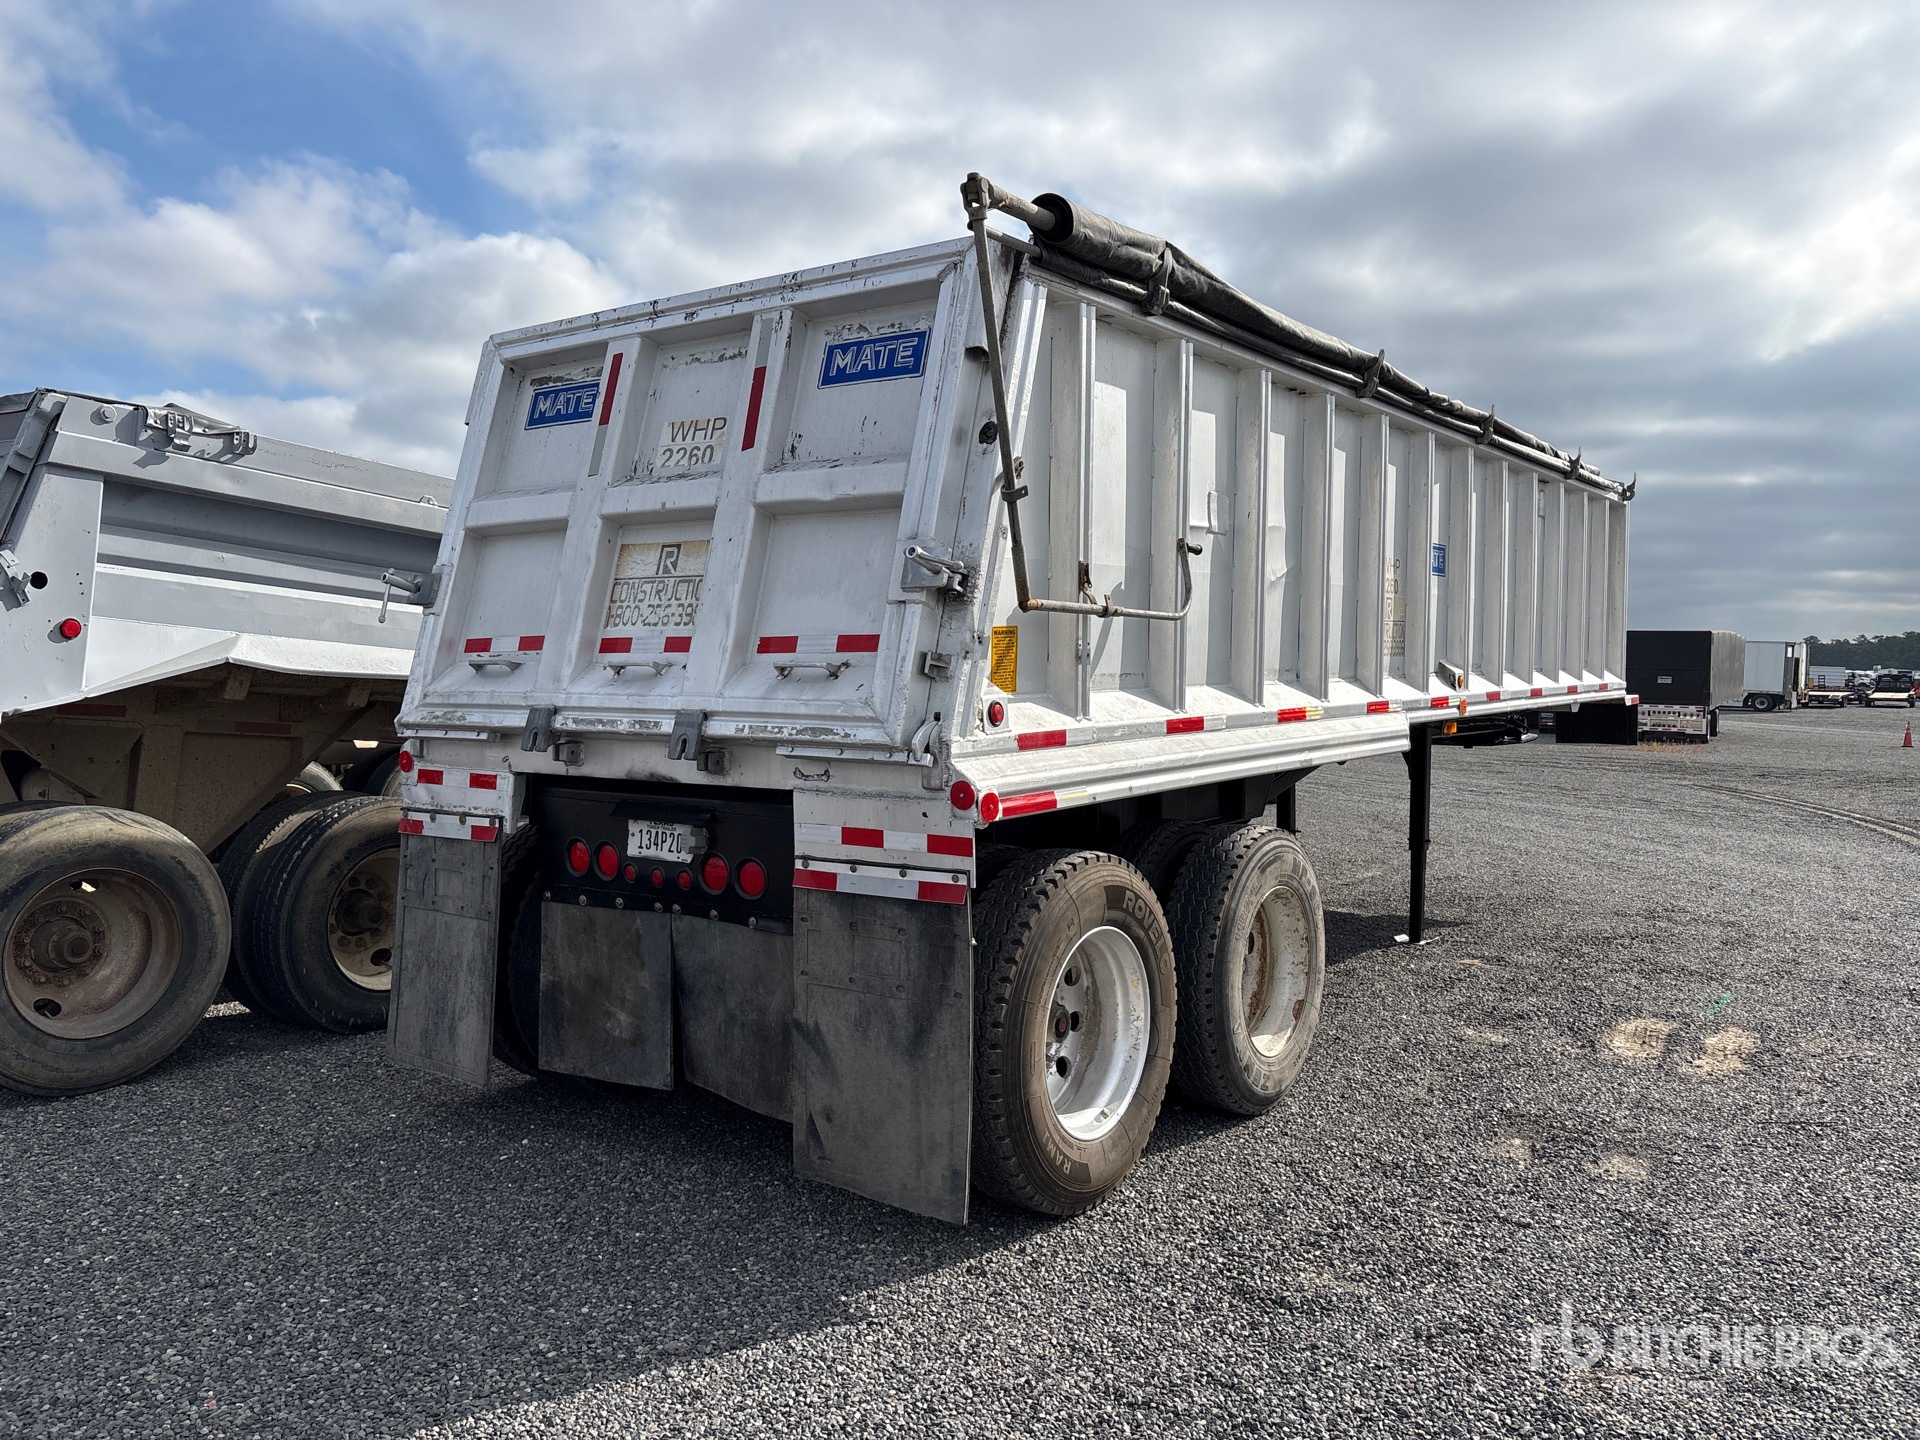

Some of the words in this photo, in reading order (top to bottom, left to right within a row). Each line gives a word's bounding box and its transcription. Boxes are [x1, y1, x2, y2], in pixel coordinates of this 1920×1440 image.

[829, 337, 918, 376] MATE
[533, 387, 597, 419] MATE
[671, 416, 727, 443] WHP
[660, 444, 715, 468] 2260
[1123, 889, 1170, 976] ROVELO
